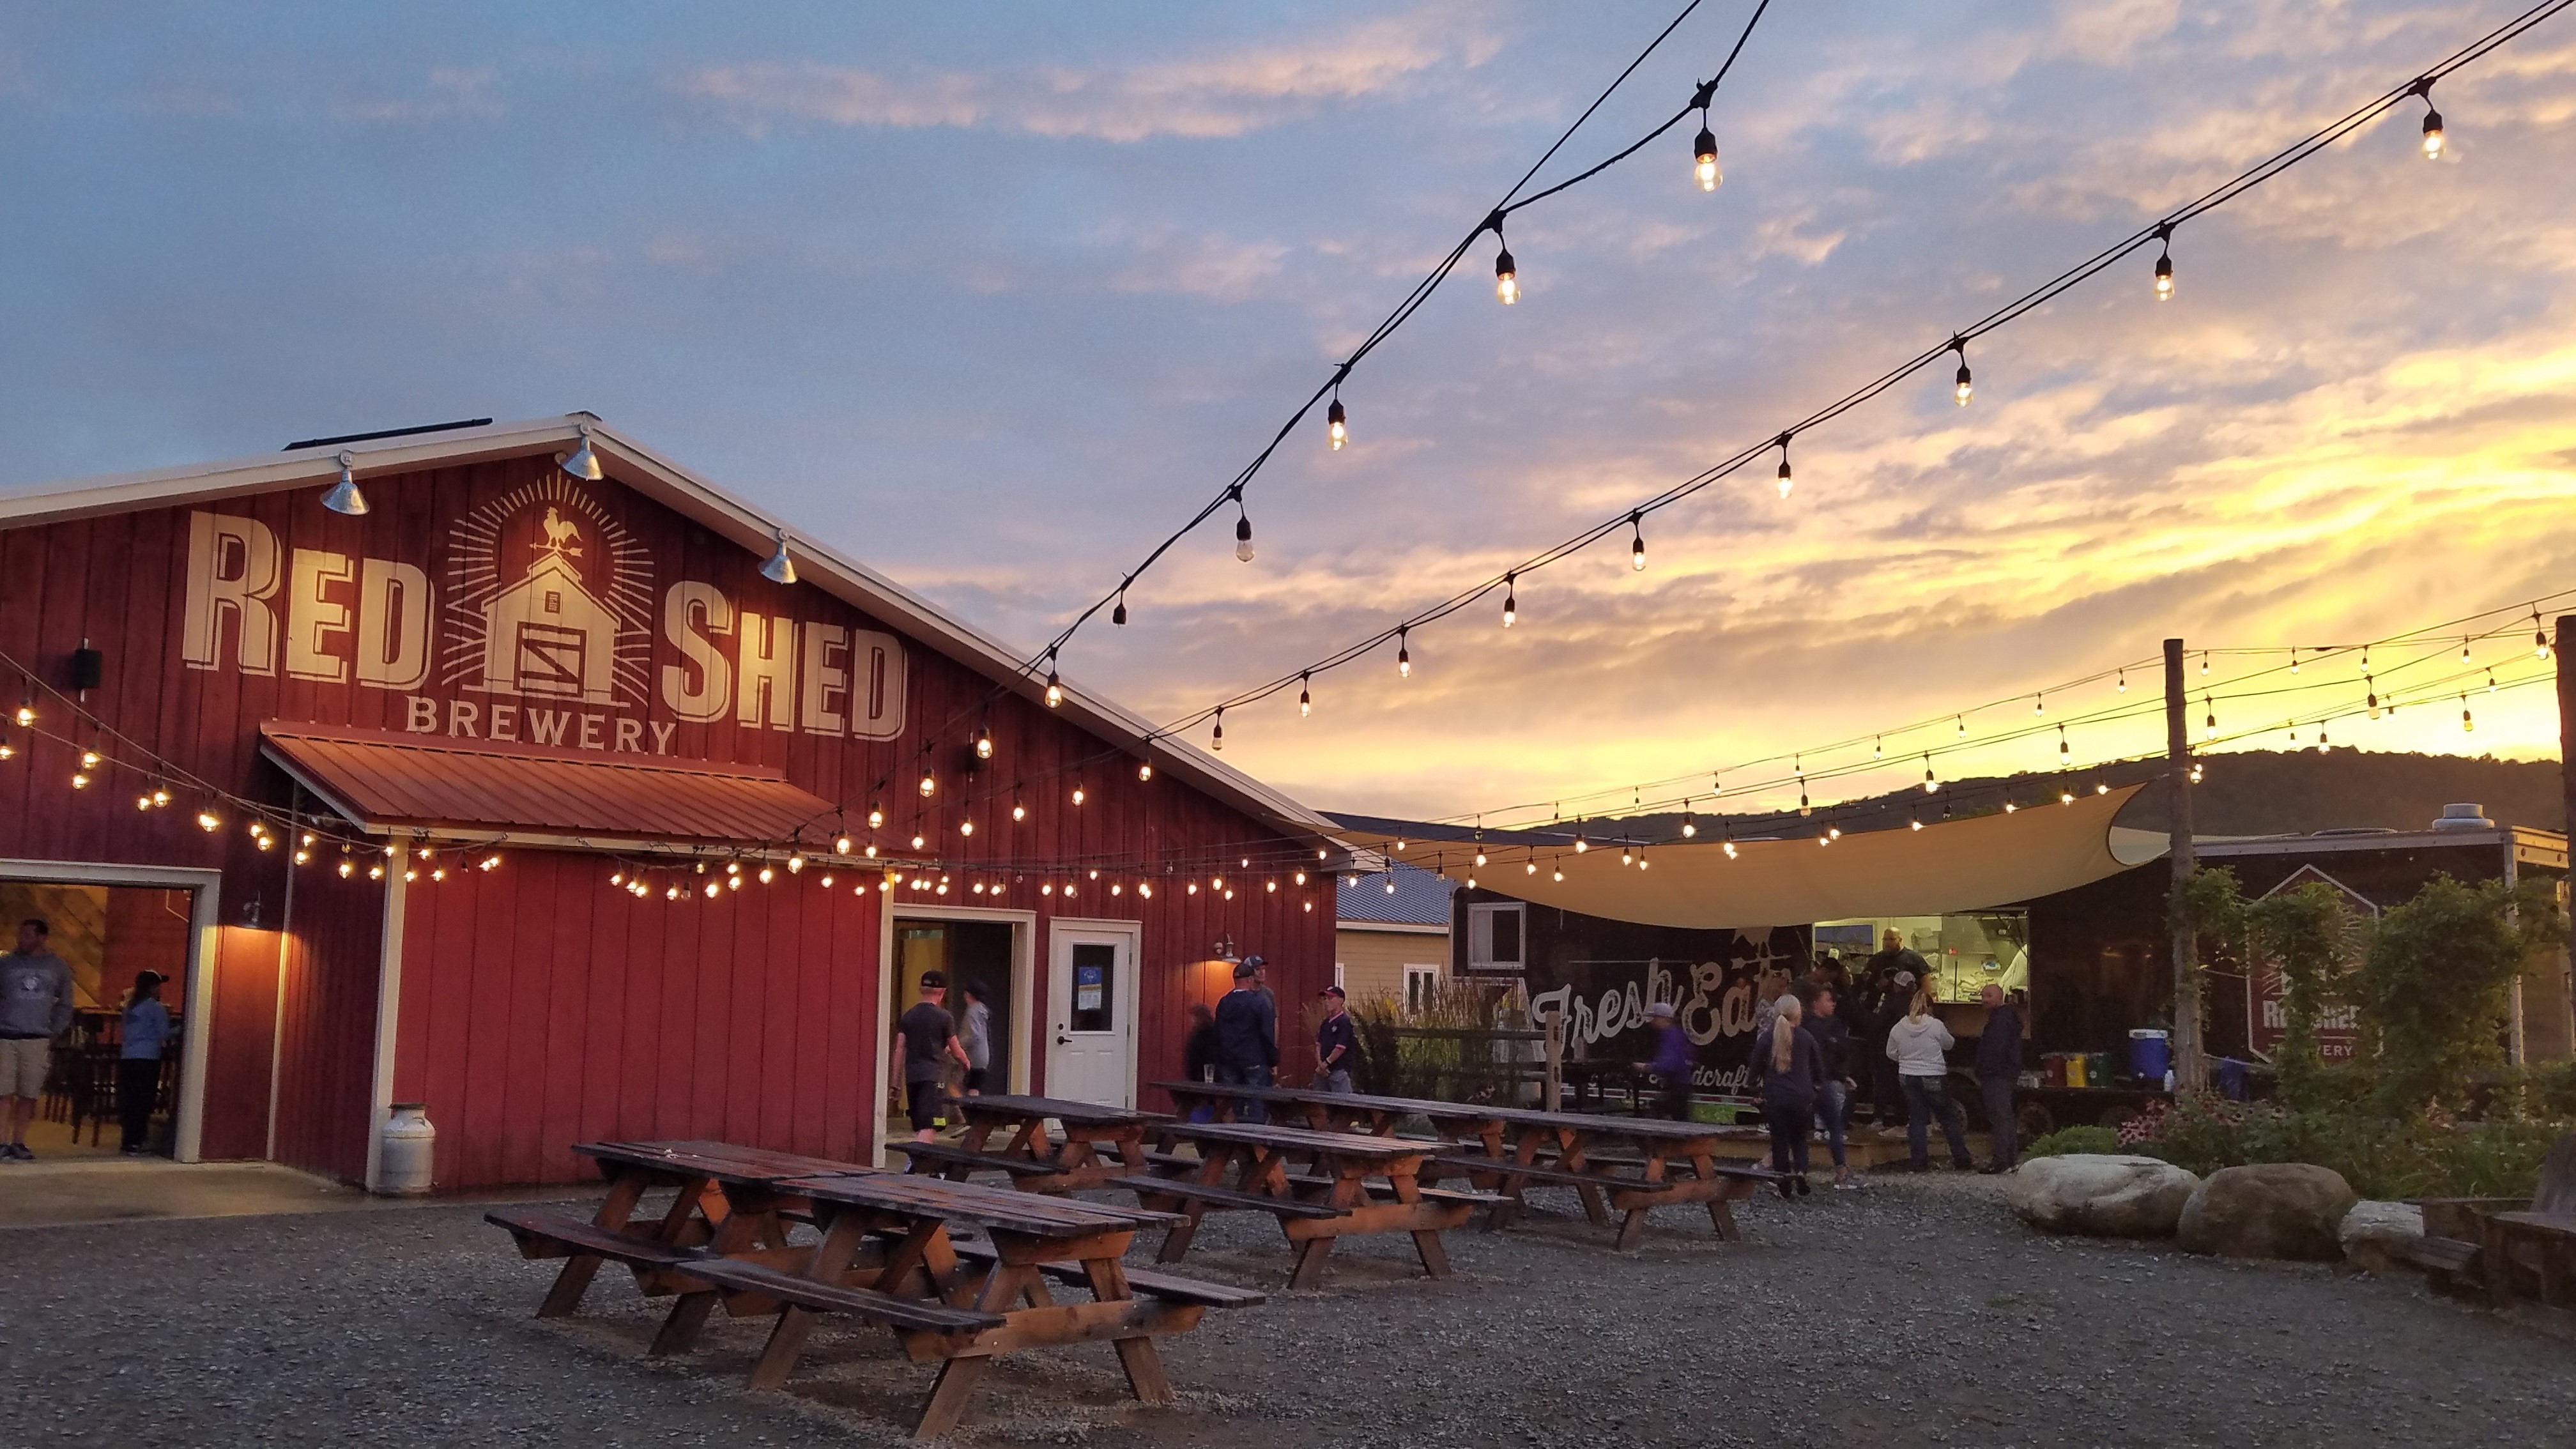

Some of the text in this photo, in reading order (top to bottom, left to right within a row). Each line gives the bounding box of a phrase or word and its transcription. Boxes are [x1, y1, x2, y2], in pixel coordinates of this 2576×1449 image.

[182, 510, 908, 742] RED SHED
[404, 695, 677, 755] BREWERY
[1531, 957, 1684, 1057] Fresh
